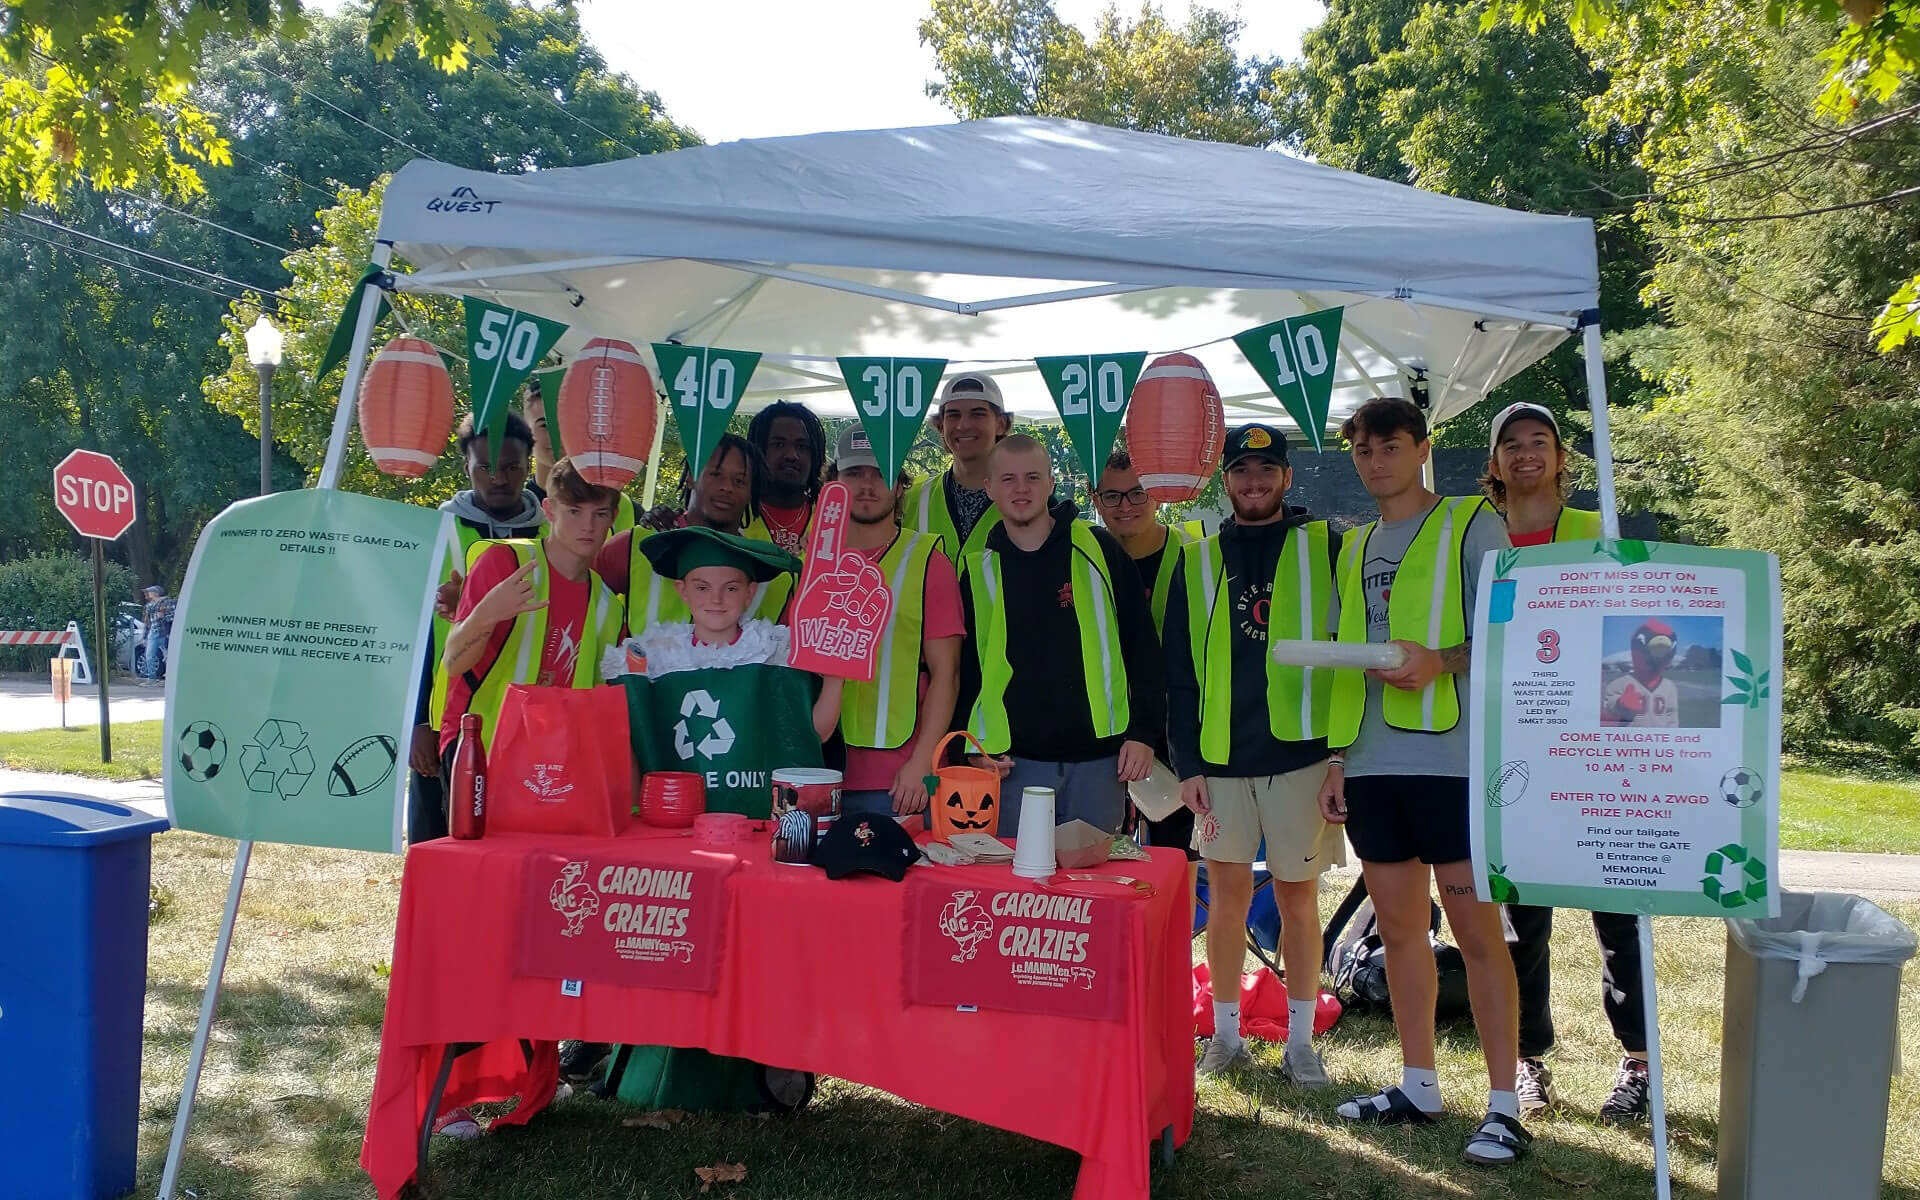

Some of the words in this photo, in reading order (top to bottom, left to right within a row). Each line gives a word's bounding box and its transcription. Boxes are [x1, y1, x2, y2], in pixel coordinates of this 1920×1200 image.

[426, 199, 502, 214] QUEST
[474, 310, 541, 370] 50
[1268, 323, 1328, 387] 10
[673, 356, 736, 409] 40
[1061, 361, 1124, 416] 20
[861, 365, 923, 417] 30
[61, 474, 129, 514] STOP
[220, 529, 257, 537] WINNER
[260, 529, 273, 537] TO
[276, 530, 305, 539] ZERO
[309, 531, 349, 542] WASTE
[353, 535, 390, 547] GAME
[393, 539, 420, 550] DAY
[816, 527, 835, 561] 1
[279, 543, 325, 554] DETAILS
[1560, 572, 1599, 581] DON'T
[1604, 571, 1638, 580] MISS
[1643, 571, 1672, 580] OUT
[1675, 572, 1696, 581] ON
[1538, 585, 1624, 596] OTTERBEIN'S
[1629, 585, 1666, 594] ZERO
[1670, 586, 1719, 595] WASTE
[1527, 600, 1566, 609] GAME
[1569, 599, 1600, 609] DAY:
[1603, 599, 1625, 608] Sat
[1631, 598, 1660, 610] Sept
[1665, 599, 1684, 610] 16,
[270, 619, 302, 629] MUST
[305, 622, 321, 630] BE
[324, 623, 378, 634] PRESENT
[237, 630, 262, 640] WILL
[266, 632, 280, 641] BE
[283, 634, 358, 647] ANNOUNCED
[361, 640, 376, 649] AT
[378, 642, 386, 650] 3
[390, 643, 410, 652] PM
[1536, 628, 1560, 664] 3
[224, 643, 269, 655] WINNER
[272, 647, 298, 657] WILL
[301, 649, 350, 661] RECEIVE
[353, 653, 361, 661] A
[364, 654, 392, 664] TEXT
[1537, 699, 1570, 707] (ZWGD)
[1559, 732, 1601, 742] COME
[1605, 733, 1670, 743] TAILGATE
[1674, 734, 1701, 743] and
[1548, 748, 1612, 757] RECYCLE
[1616, 748, 1650, 757] WITH
[1655, 749, 1674, 758] US
[1679, 749, 1712, 759] from
[1585, 763, 1599, 772] 10
[1604, 763, 1625, 772] AM
[1638, 764, 1647, 773] 3
[1651, 764, 1673, 773] PM
[725, 770, 766, 788] ONLY
[1622, 779, 1631, 788] &
[474, 775, 483, 816] SWACO
[1550, 792, 1594, 801] ENTER
[1598, 793, 1616, 802] TO
[1620, 794, 1647, 803] WIN
[1651, 794, 1661, 803] A
[1665, 795, 1709, 804] ZWGD
[1581, 808, 1621, 817] PRIZE
[1625, 809, 1672, 819] PACK!!
[1587, 826, 1611, 835] Find
[1636, 829, 1680, 838] tailgate
[1577, 840, 1605, 848] party
[1638, 841, 1656, 849] the
[1660, 842, 1691, 850] GATE
[1596, 852, 1604, 860] B
[1607, 853, 1658, 862] Entrance
[1661, 855, 1672, 863] @
[1602, 865, 1666, 875] MEMORIAL
[598, 865, 693, 900] CARDINAL
[1604, 878, 1657, 887] STADIUM
[992, 892, 1093, 924] CARDINAL
[603, 903, 690, 937] CRAZIES
[998, 925, 1089, 963] CRAZIES
